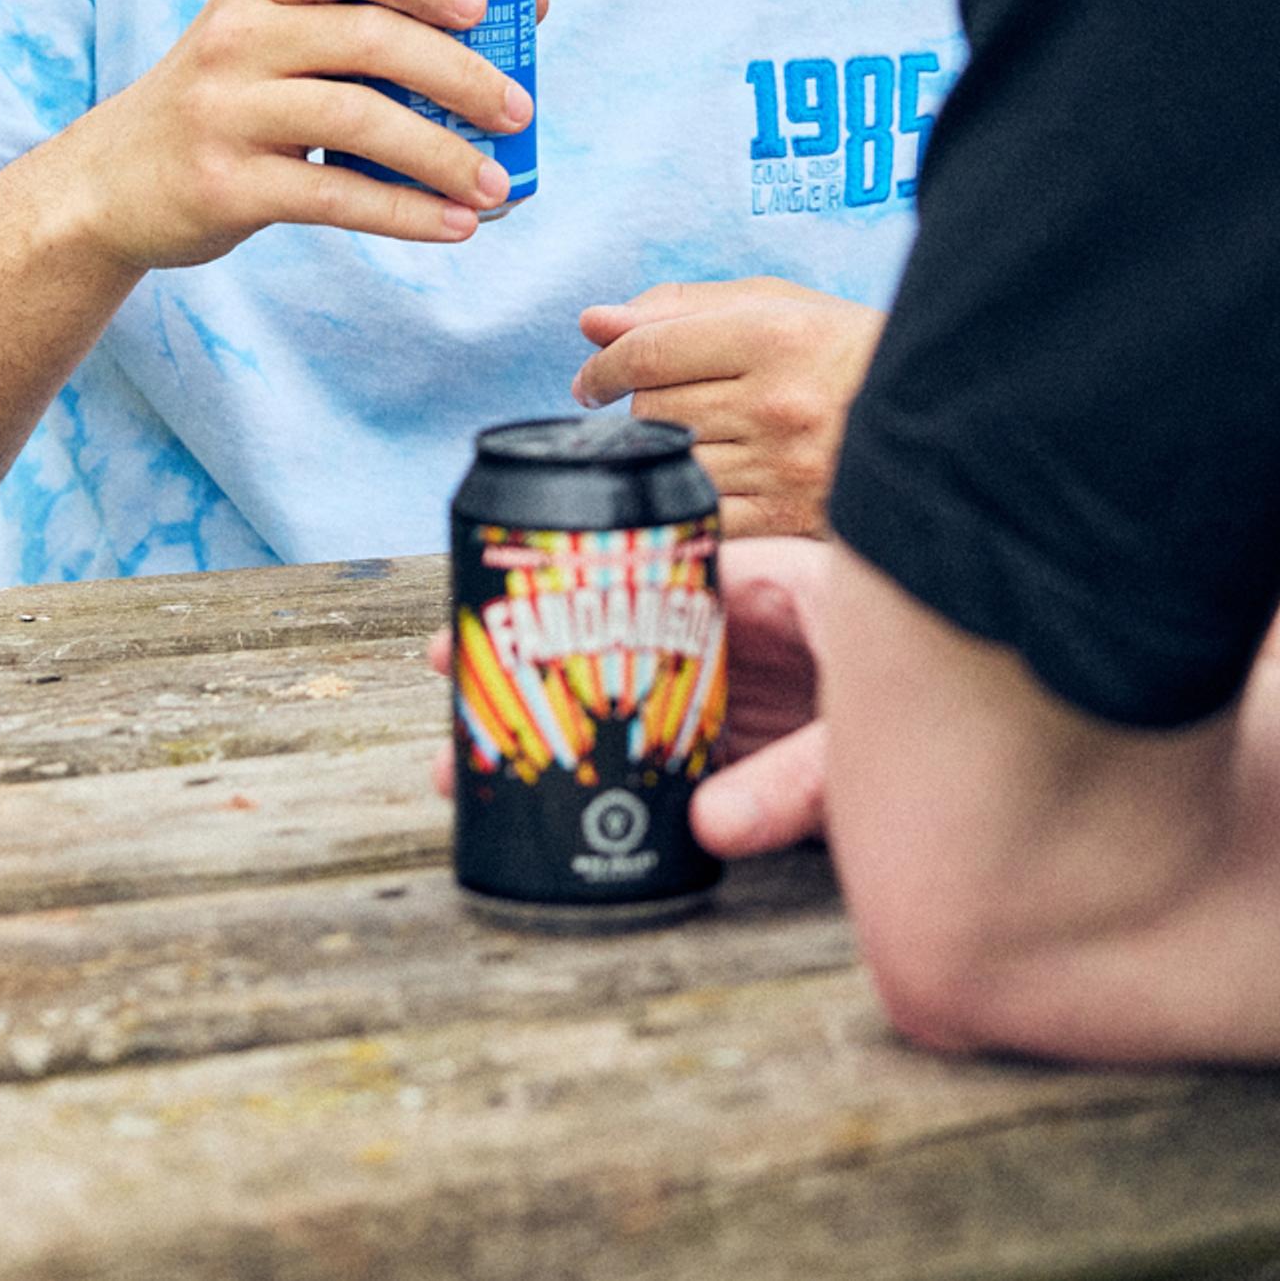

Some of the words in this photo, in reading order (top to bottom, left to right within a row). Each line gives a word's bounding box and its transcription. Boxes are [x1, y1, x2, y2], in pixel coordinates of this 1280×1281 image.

[469, 27, 516, 45] PREMIUM
[745, 52, 940, 208] 1985
[751, 184, 841, 216] LAGER
